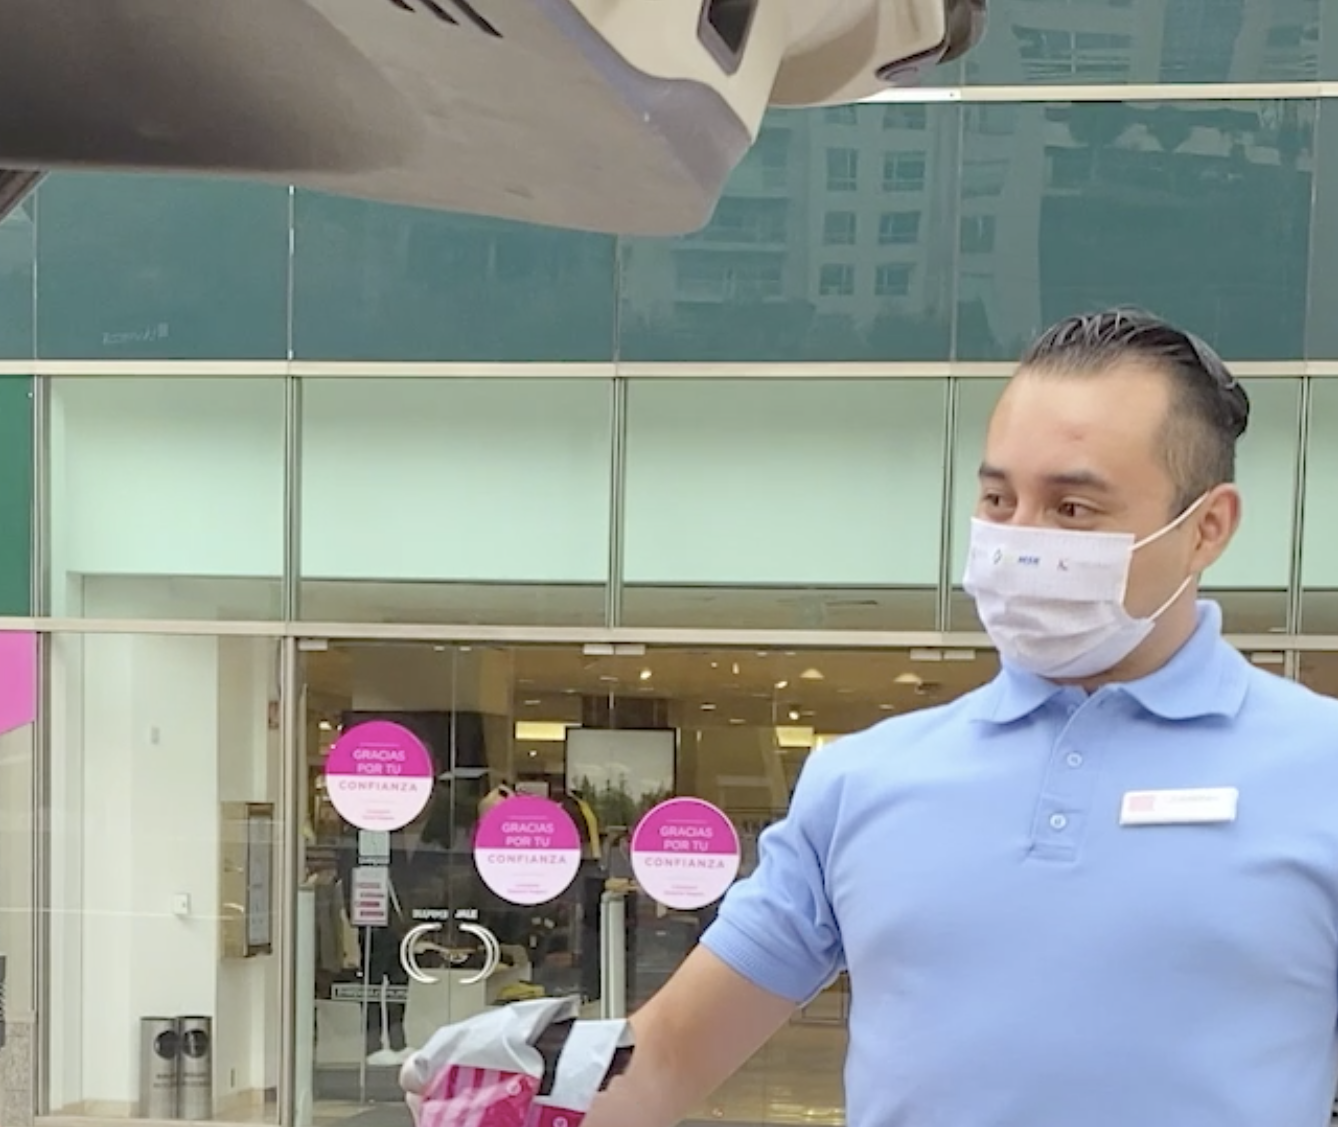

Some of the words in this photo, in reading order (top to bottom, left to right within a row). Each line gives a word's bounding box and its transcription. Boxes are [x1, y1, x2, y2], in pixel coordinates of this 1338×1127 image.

[352, 748, 406, 762] GRACIAS
[356, 762, 383, 774] POR
[385, 763, 402, 775] TU
[339, 780, 418, 792] CONFIANZA
[501, 822, 555, 835] GRACIAS
[659, 825, 714, 839] GRACIAS
[505, 836, 531, 847] POR
[534, 836, 551, 848] TU
[663, 839, 690, 850] POR
[692, 840, 709, 852] TU
[487, 854, 567, 865] CONFIANZA
[644, 857, 726, 869] CONFIANZA
